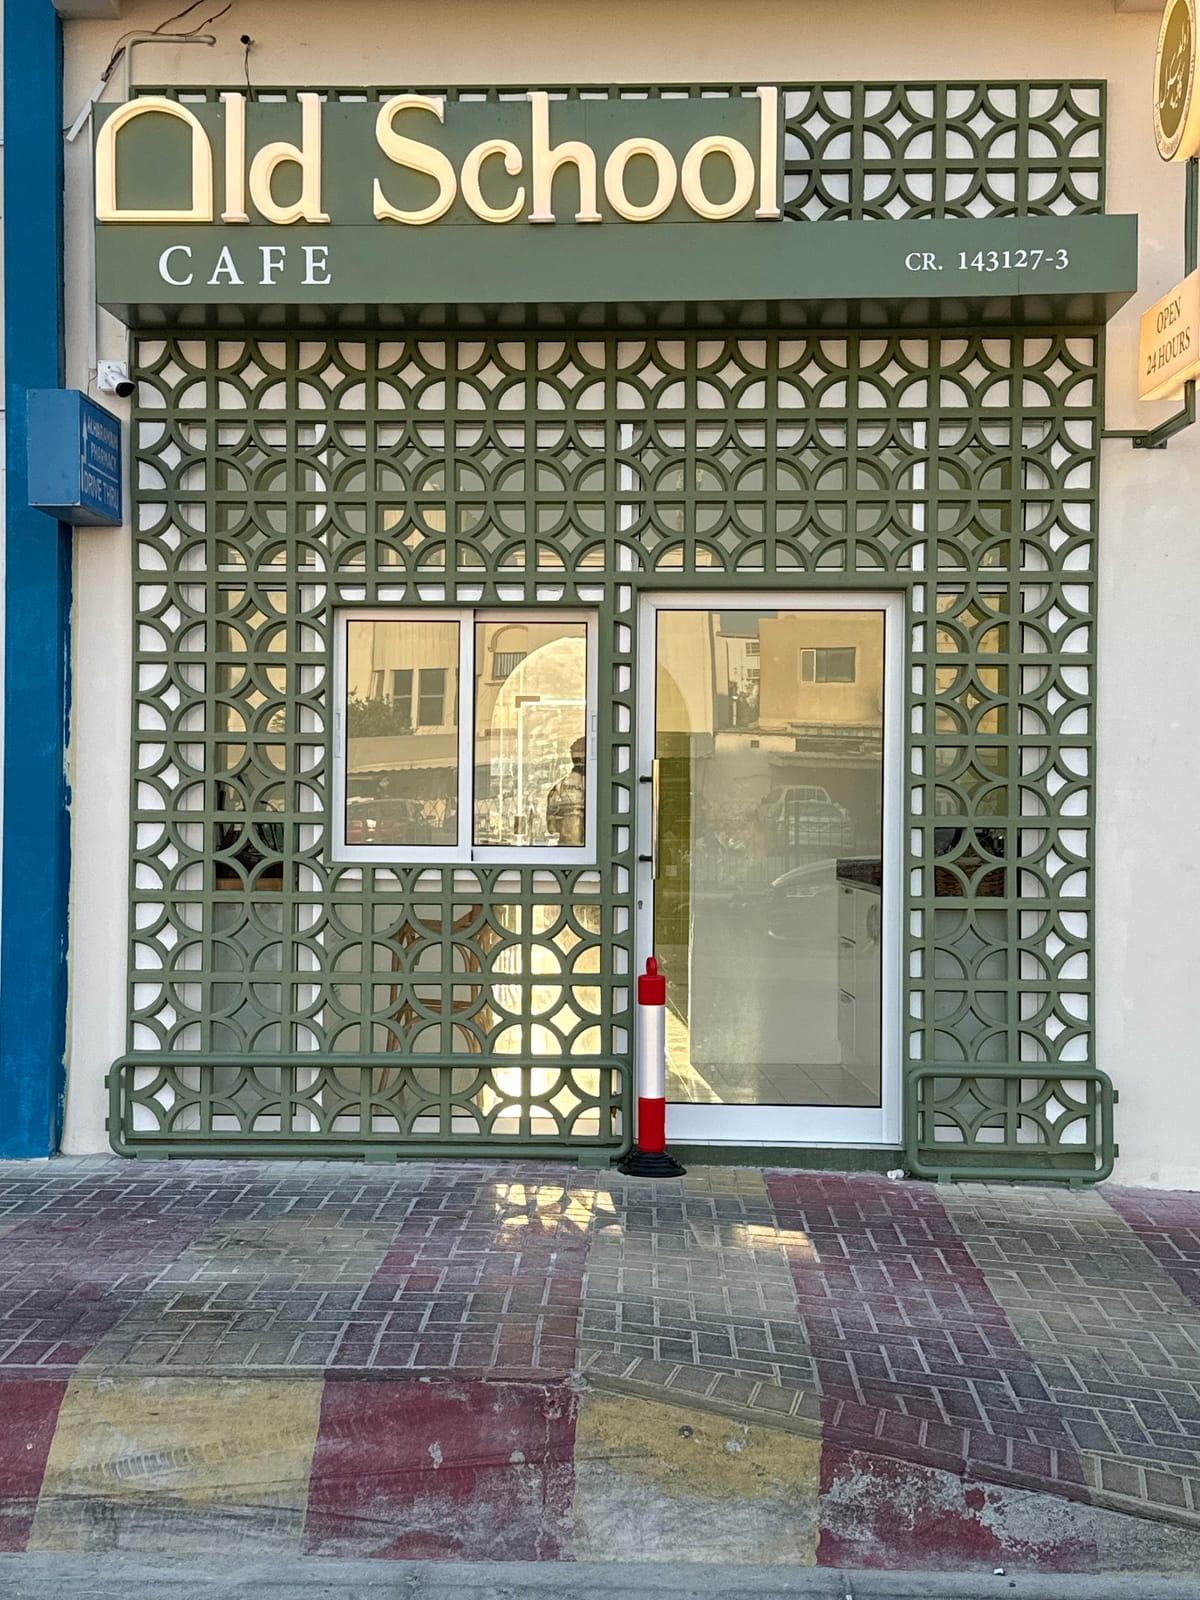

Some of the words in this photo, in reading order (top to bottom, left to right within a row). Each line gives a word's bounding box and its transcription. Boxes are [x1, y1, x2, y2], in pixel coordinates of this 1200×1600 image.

[373, 86, 783, 226] School
[158, 245, 332, 287] CAFE
[904, 252, 943, 272] CR.
[957, 249, 1070, 273] 143127-3
[1156, 295, 1182, 334] OPEN
[1146, 351, 1157, 376] 24
[1158, 326, 1191, 370] HOURS
[83, 469, 103, 503] DRIVE
